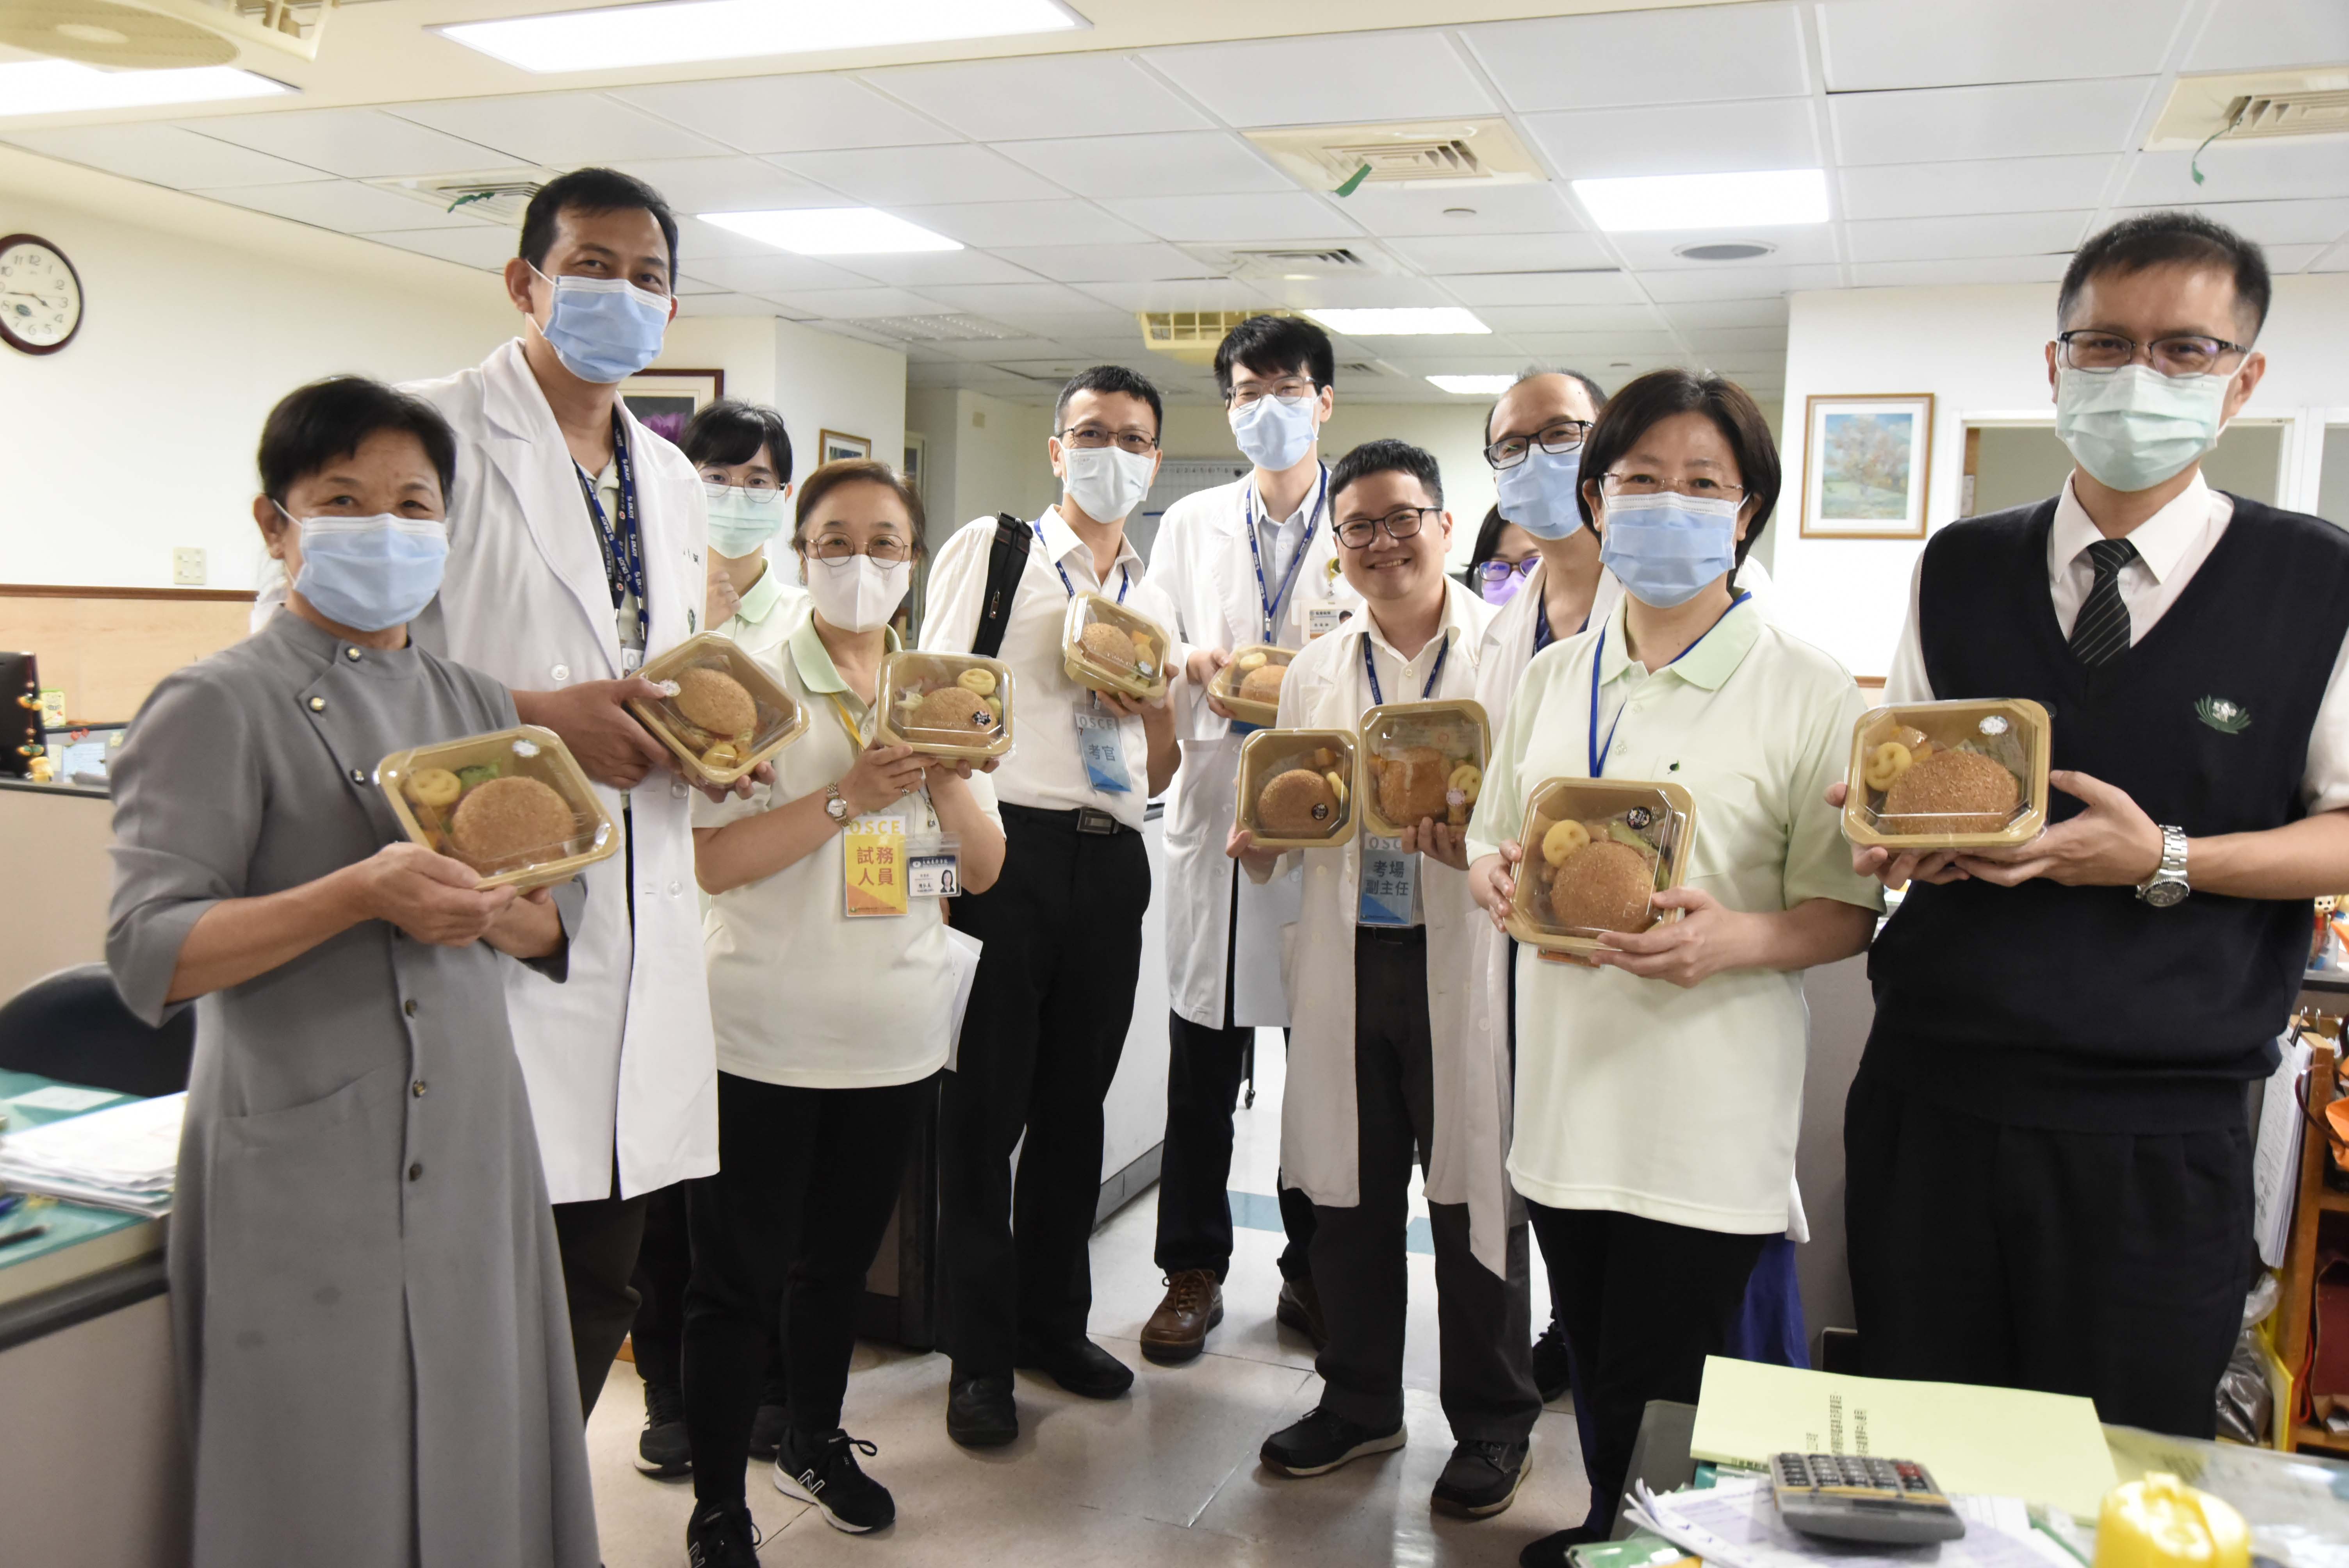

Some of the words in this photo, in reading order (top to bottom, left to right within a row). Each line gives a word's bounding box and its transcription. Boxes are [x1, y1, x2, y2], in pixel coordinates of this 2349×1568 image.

[14, 255, 23, 265] 11
[29, 255, 41, 266] 12
[1, 266, 13, 277] 10
[48, 265, 53, 274] 1
[55, 279, 65, 290] 2
[1, 300, 11, 312] 8
[59, 297, 68, 308] 3
[13, 316, 21, 328] 7
[54, 314, 64, 323] 4
[28, 324, 37, 336] 6
[43, 324, 52, 335] 5
[1079, 716, 1114, 729] OSCE
[1078, 727, 1084, 736] 7
[1088, 743, 1116, 762] 考官
[849, 820, 901, 835] OSCE
[856, 846, 894, 865] 試務
[1373, 860, 1405, 878] 考場
[857, 868, 894, 886] 人員
[1366, 879, 1409, 896] 副主任
